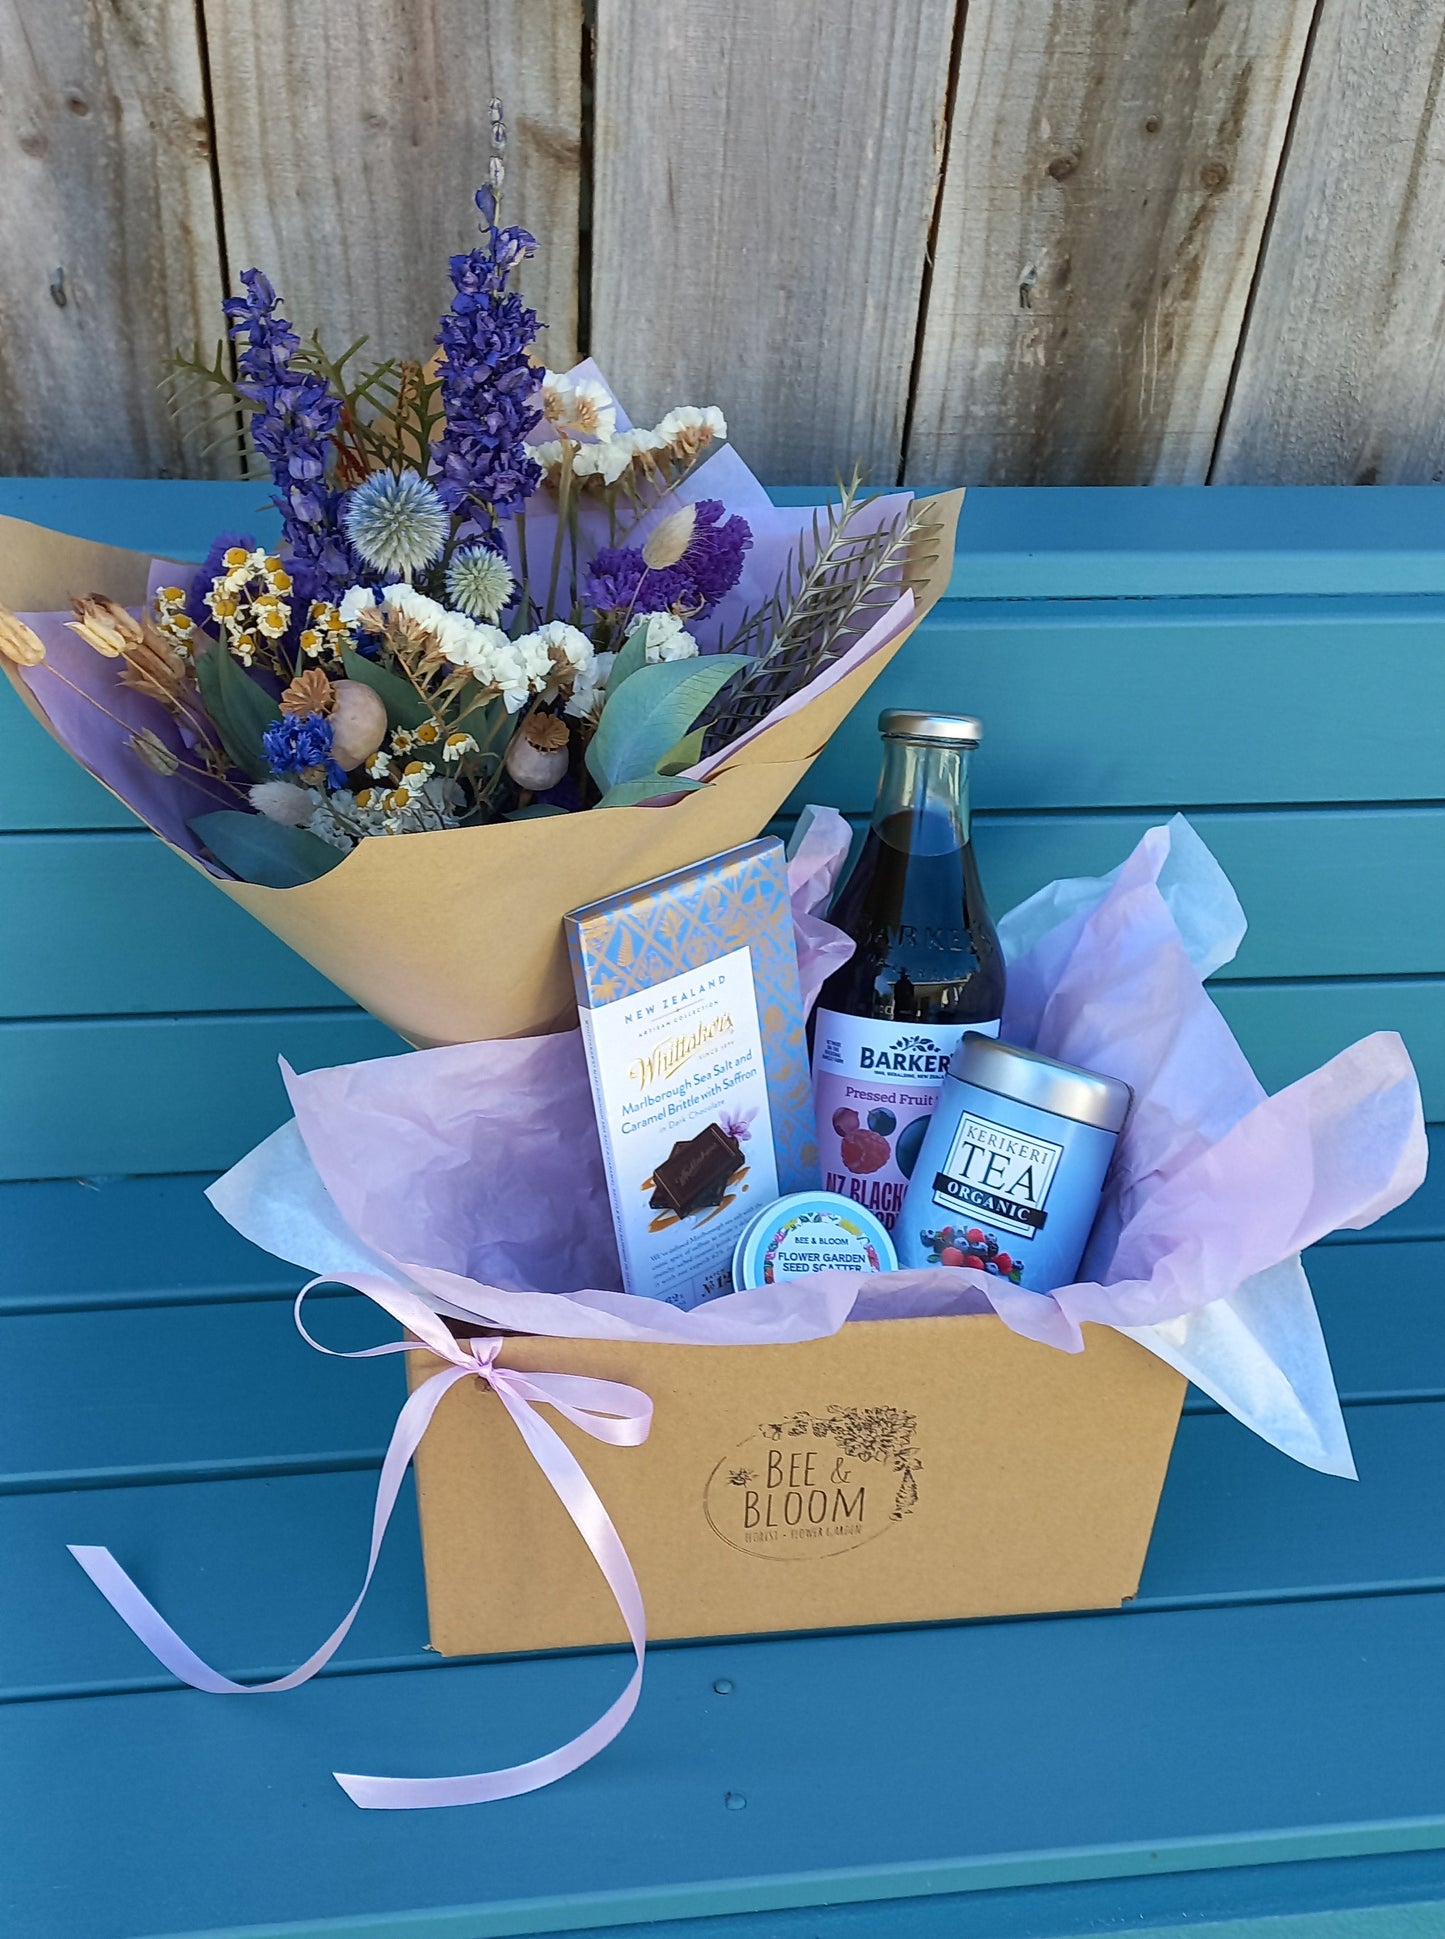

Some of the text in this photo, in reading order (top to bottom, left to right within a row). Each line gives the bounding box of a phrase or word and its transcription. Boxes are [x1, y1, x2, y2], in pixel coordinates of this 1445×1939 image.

[624, 975, 726, 1024] NEW ZEALAND
[860, 1046, 954, 1073] BARKER'
[621, 1068, 757, 1134] Caramel Brittle with Saffron
[622, 1049, 753, 1117] Marlborough Sea Salt and
[845, 1086, 934, 1106] Pressed Fruit
[668, 1117, 686, 1130] Dark
[688, 1100, 725, 1120] Chocolate
[966, 1125, 1048, 1165] KERIKERI
[958, 1140, 1037, 1203] TEA
[947, 1181, 1031, 1221] ORGANIC
[778, 1252, 866, 1263] FLOWER GARDEN
[794, 1236, 849, 1246] BEE & BLOOM
[782, 1263, 810, 1272] SEED
[766, 1449, 852, 1489] BEE &
[744, 1486, 866, 1529] BLOOM
